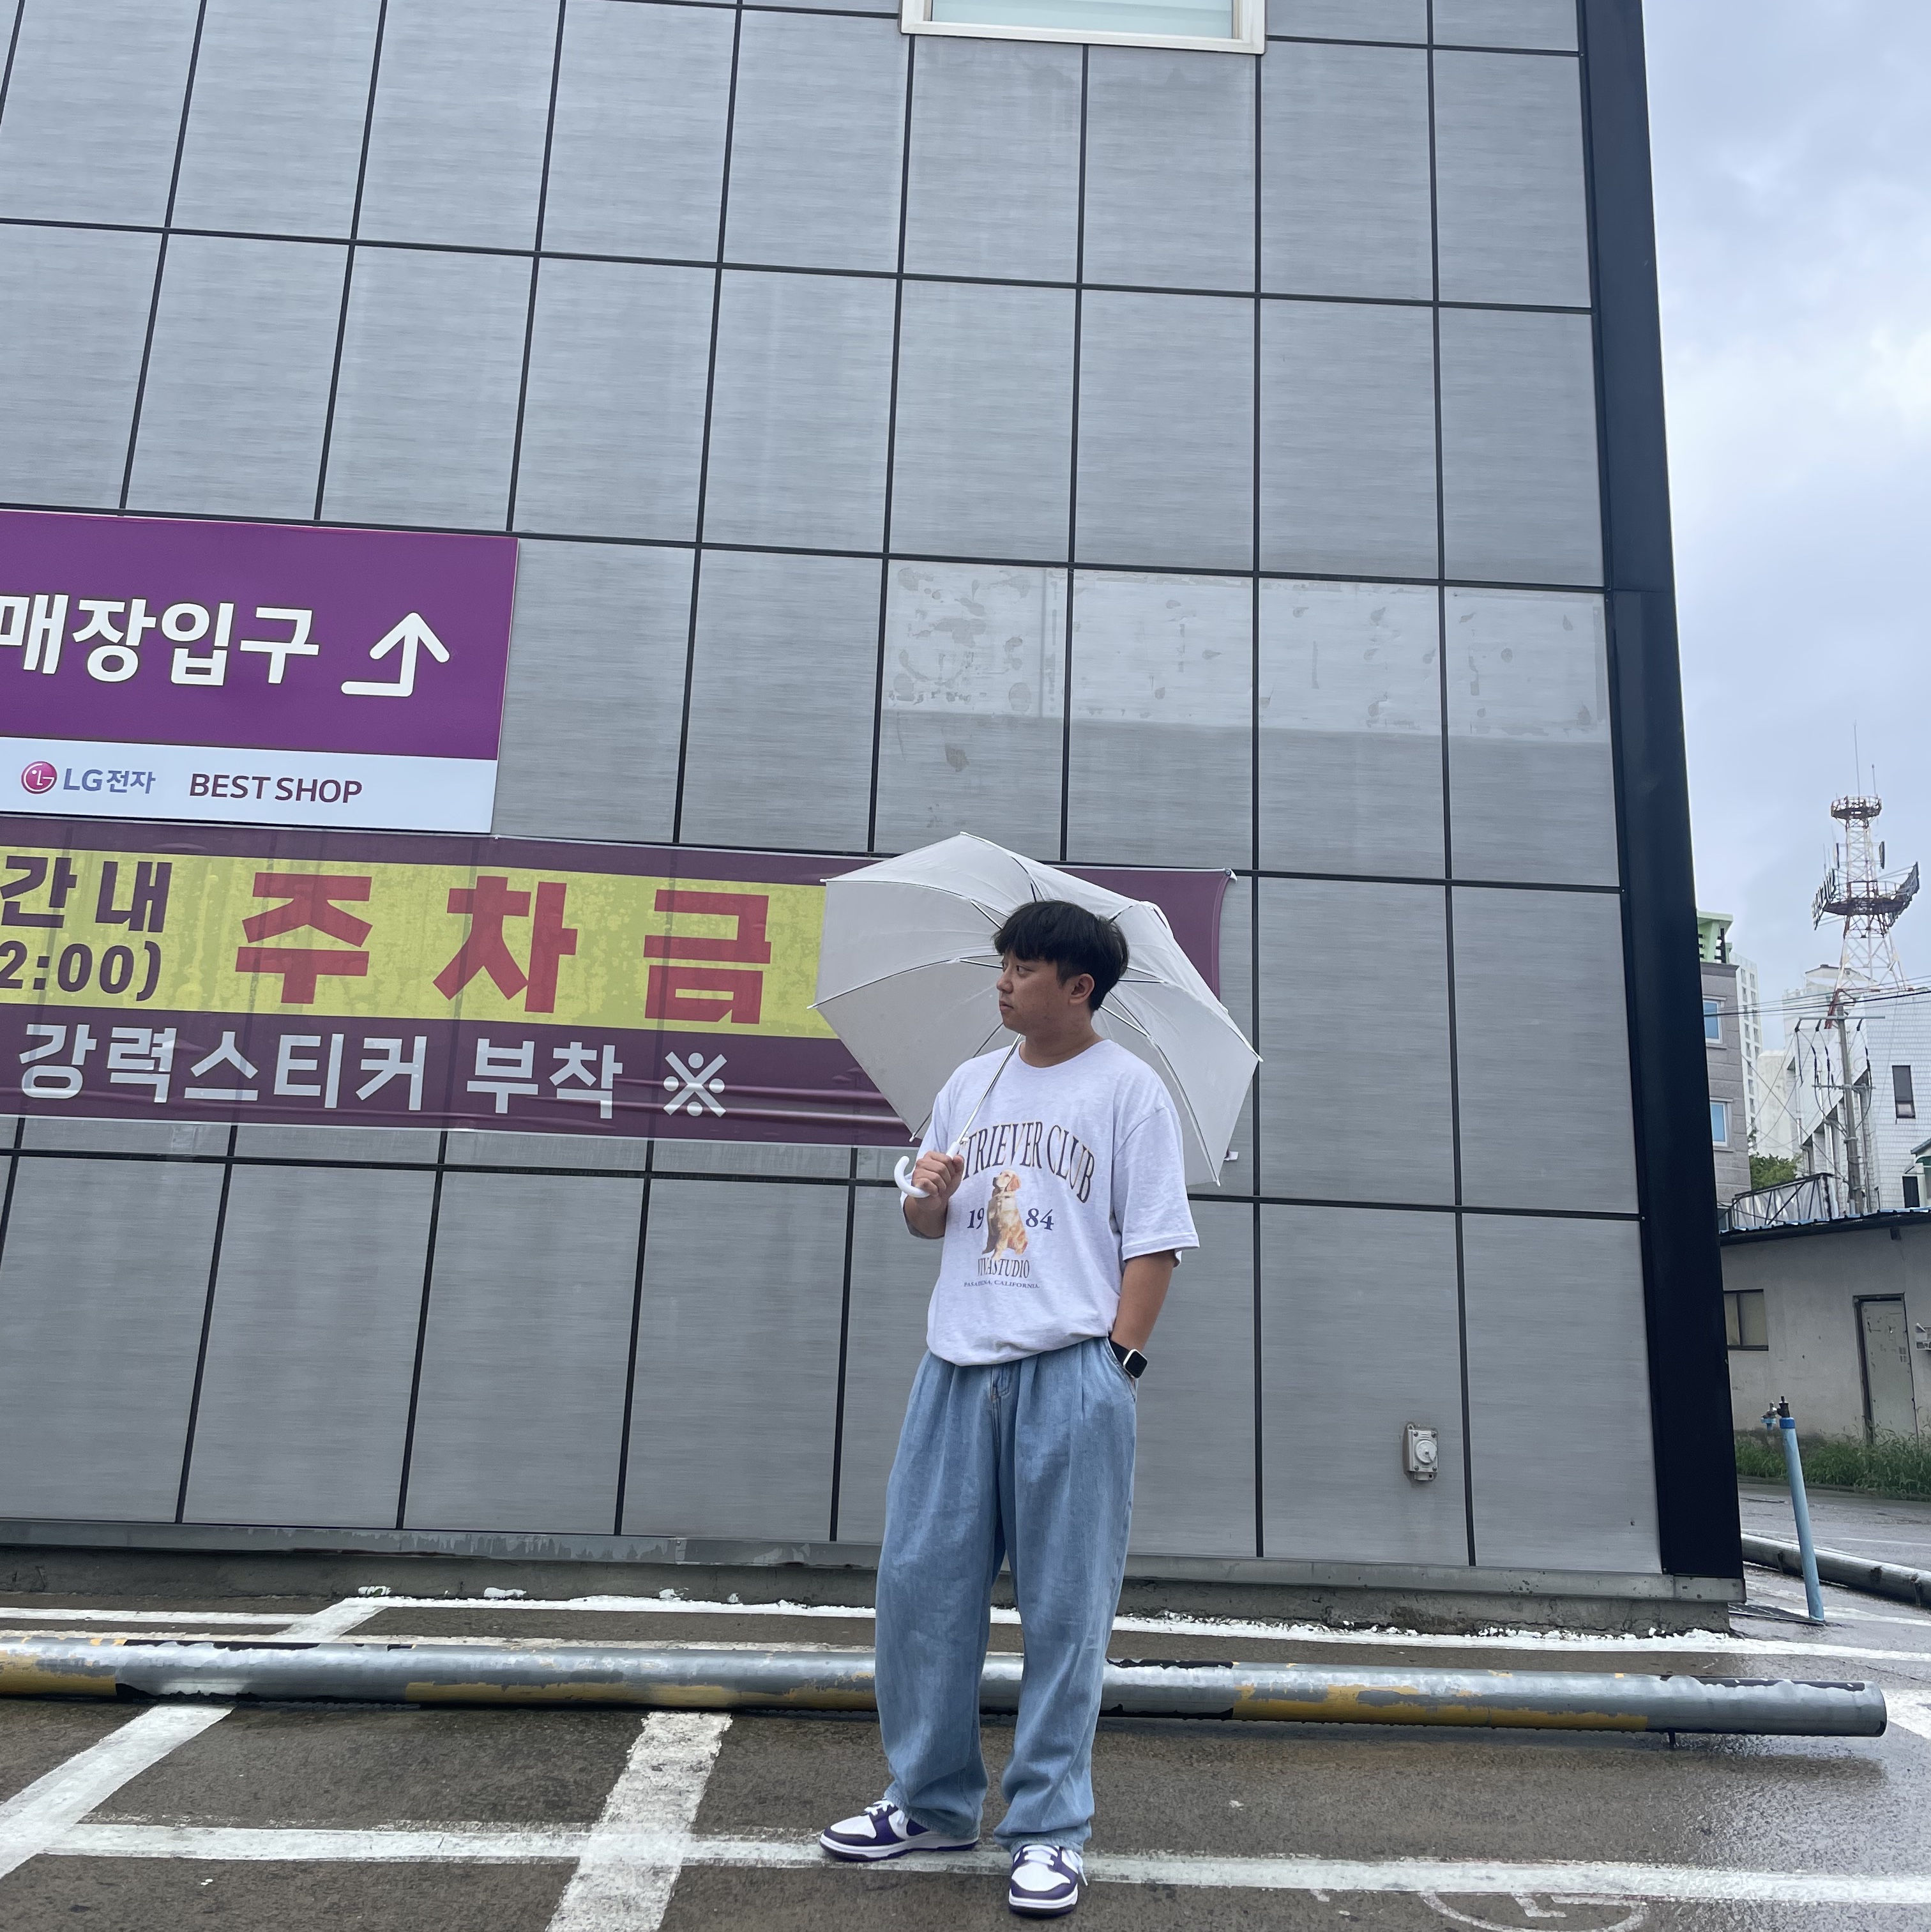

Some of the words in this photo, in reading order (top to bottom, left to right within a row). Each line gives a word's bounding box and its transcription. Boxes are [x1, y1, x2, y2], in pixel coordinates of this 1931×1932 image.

[0, 594, 320, 687] 매장입구
[63, 768, 156, 795] LG전자
[190, 773, 271, 799] BEST
[275, 777, 363, 803] SHOP
[19, 1023, 427, 1111] 강력스티커
[467, 1038, 623, 1119] 부착
[958, 1121, 1043, 1180] TRIEVER
[1047, 1125, 1095, 1203] CLUB
[967, 1207, 985, 1229] 19
[1026, 1208, 1054, 1231] 84
